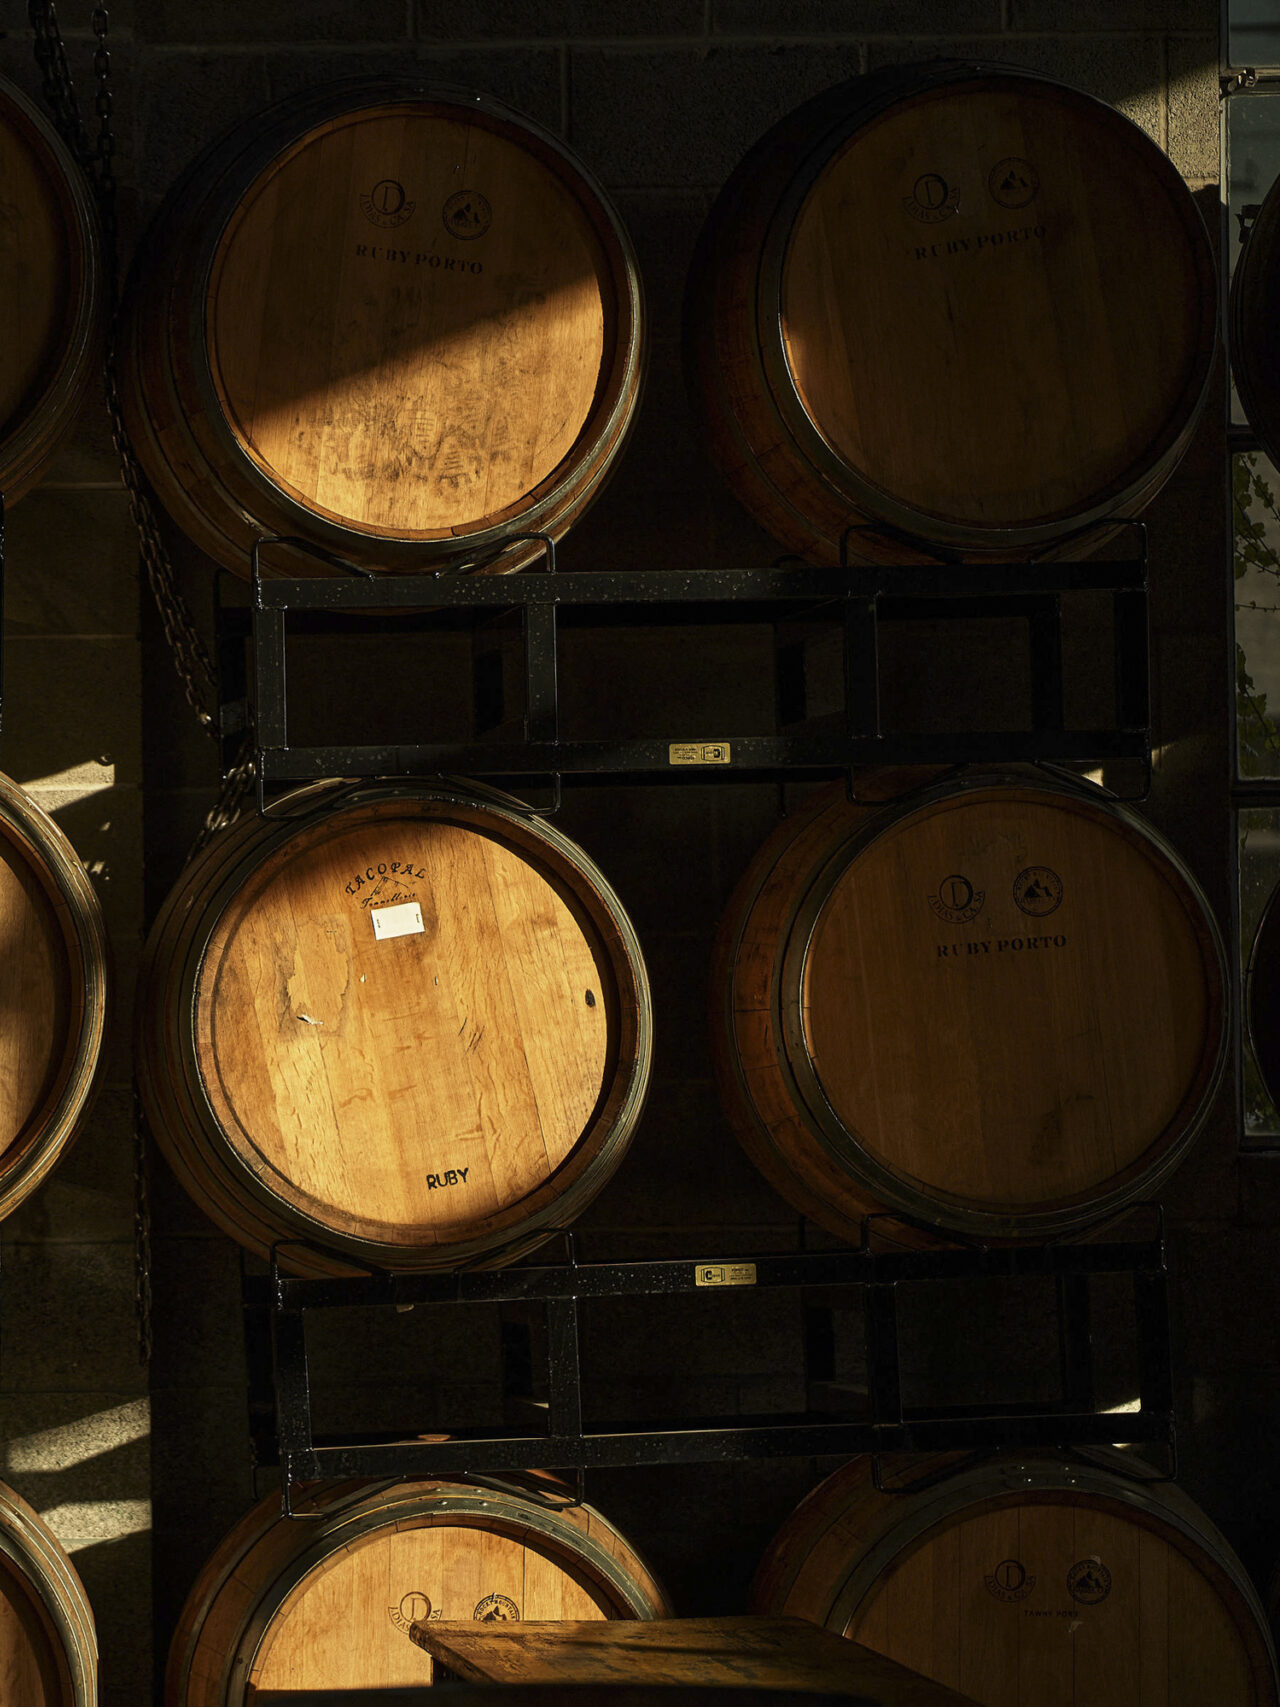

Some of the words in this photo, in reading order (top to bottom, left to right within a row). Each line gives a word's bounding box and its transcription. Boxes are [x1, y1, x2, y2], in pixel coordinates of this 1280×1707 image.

[977, 225, 1046, 248] PORTO
[415, 252, 483, 275] PORTO
[937, 940, 992, 957] RUBY
[997, 935, 1066, 952] PORTO
[426, 1167, 469, 1190] RUBY
